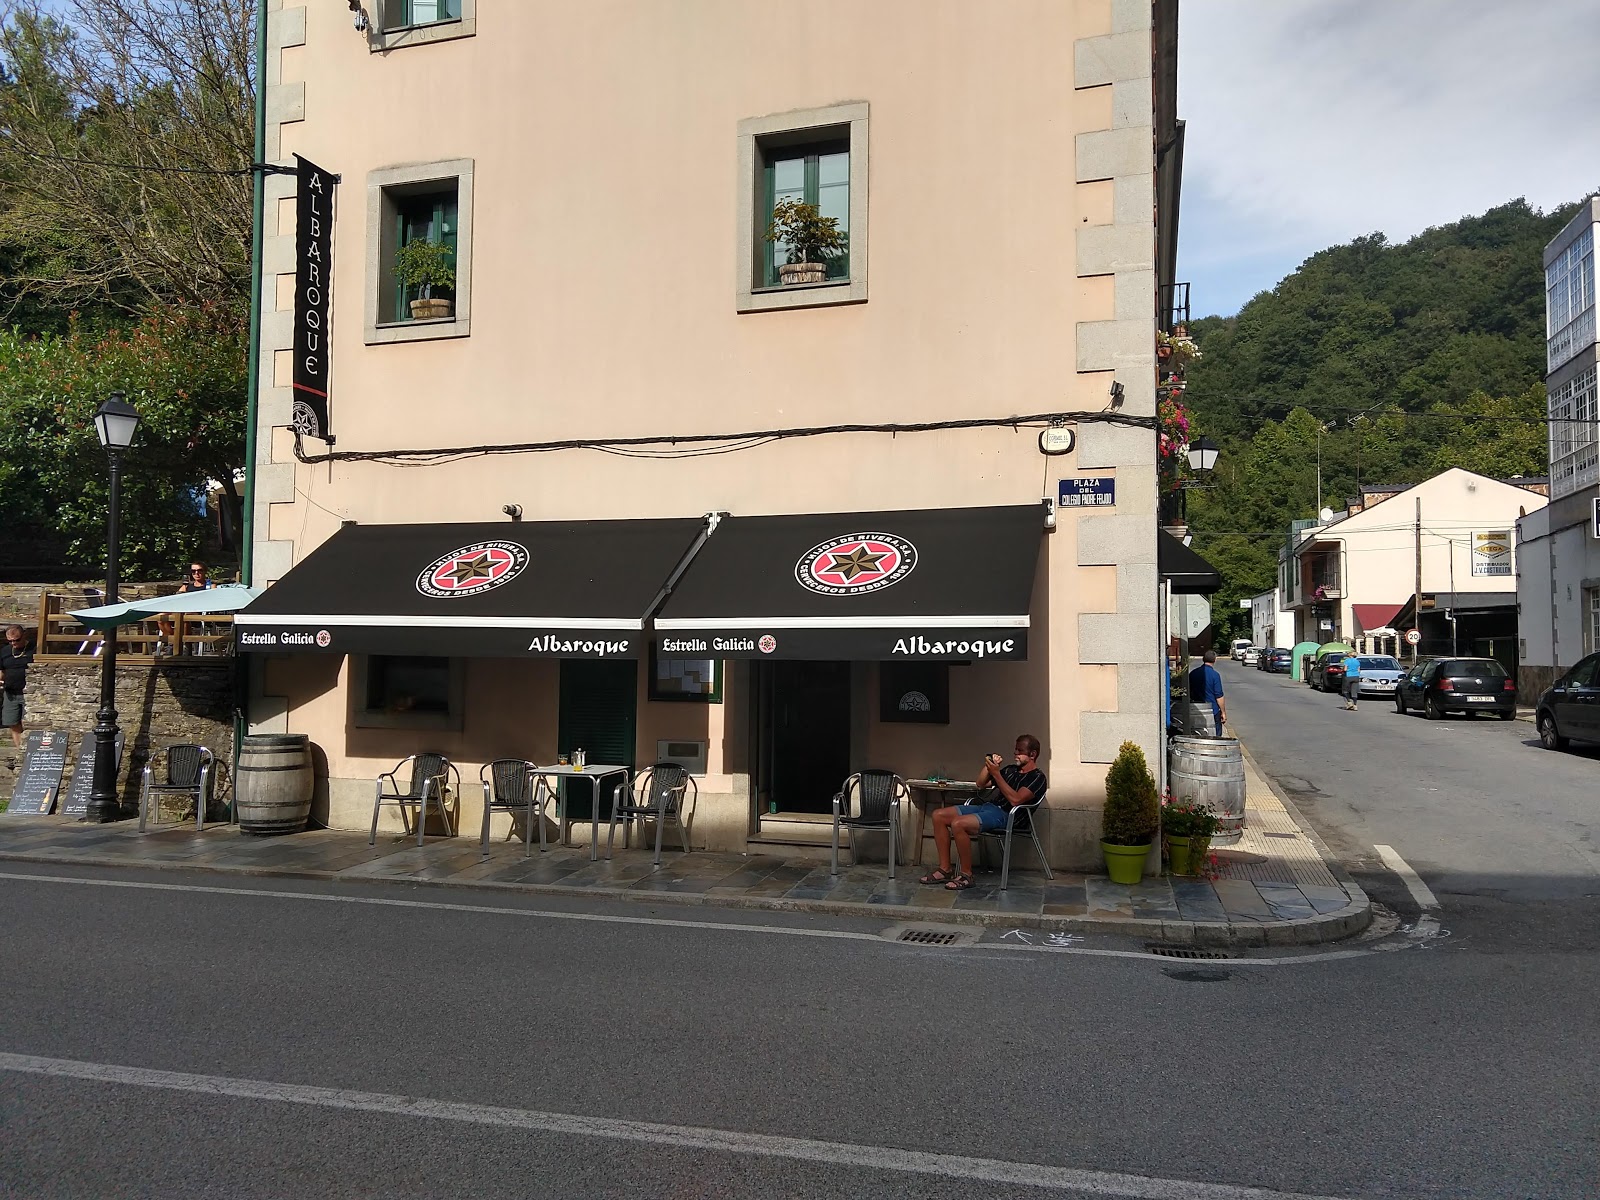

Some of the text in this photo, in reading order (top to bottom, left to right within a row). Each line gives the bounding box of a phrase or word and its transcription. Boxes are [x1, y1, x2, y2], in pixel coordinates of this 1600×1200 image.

[306, 172, 323, 375] ALBAROQUE
[1073, 479, 1100, 487] PLAZA
[807, 541, 838, 560] HIJOS
[840, 536, 855, 544] DE
[800, 564, 909, 594] CERVECEROS DESDE 1906
[240, 632, 314, 645] Estrella Galicia
[528, 634, 629, 657] Albaroque
[662, 637, 754, 651] Estrella Galicia
[892, 635, 1015, 658] Albaroque
